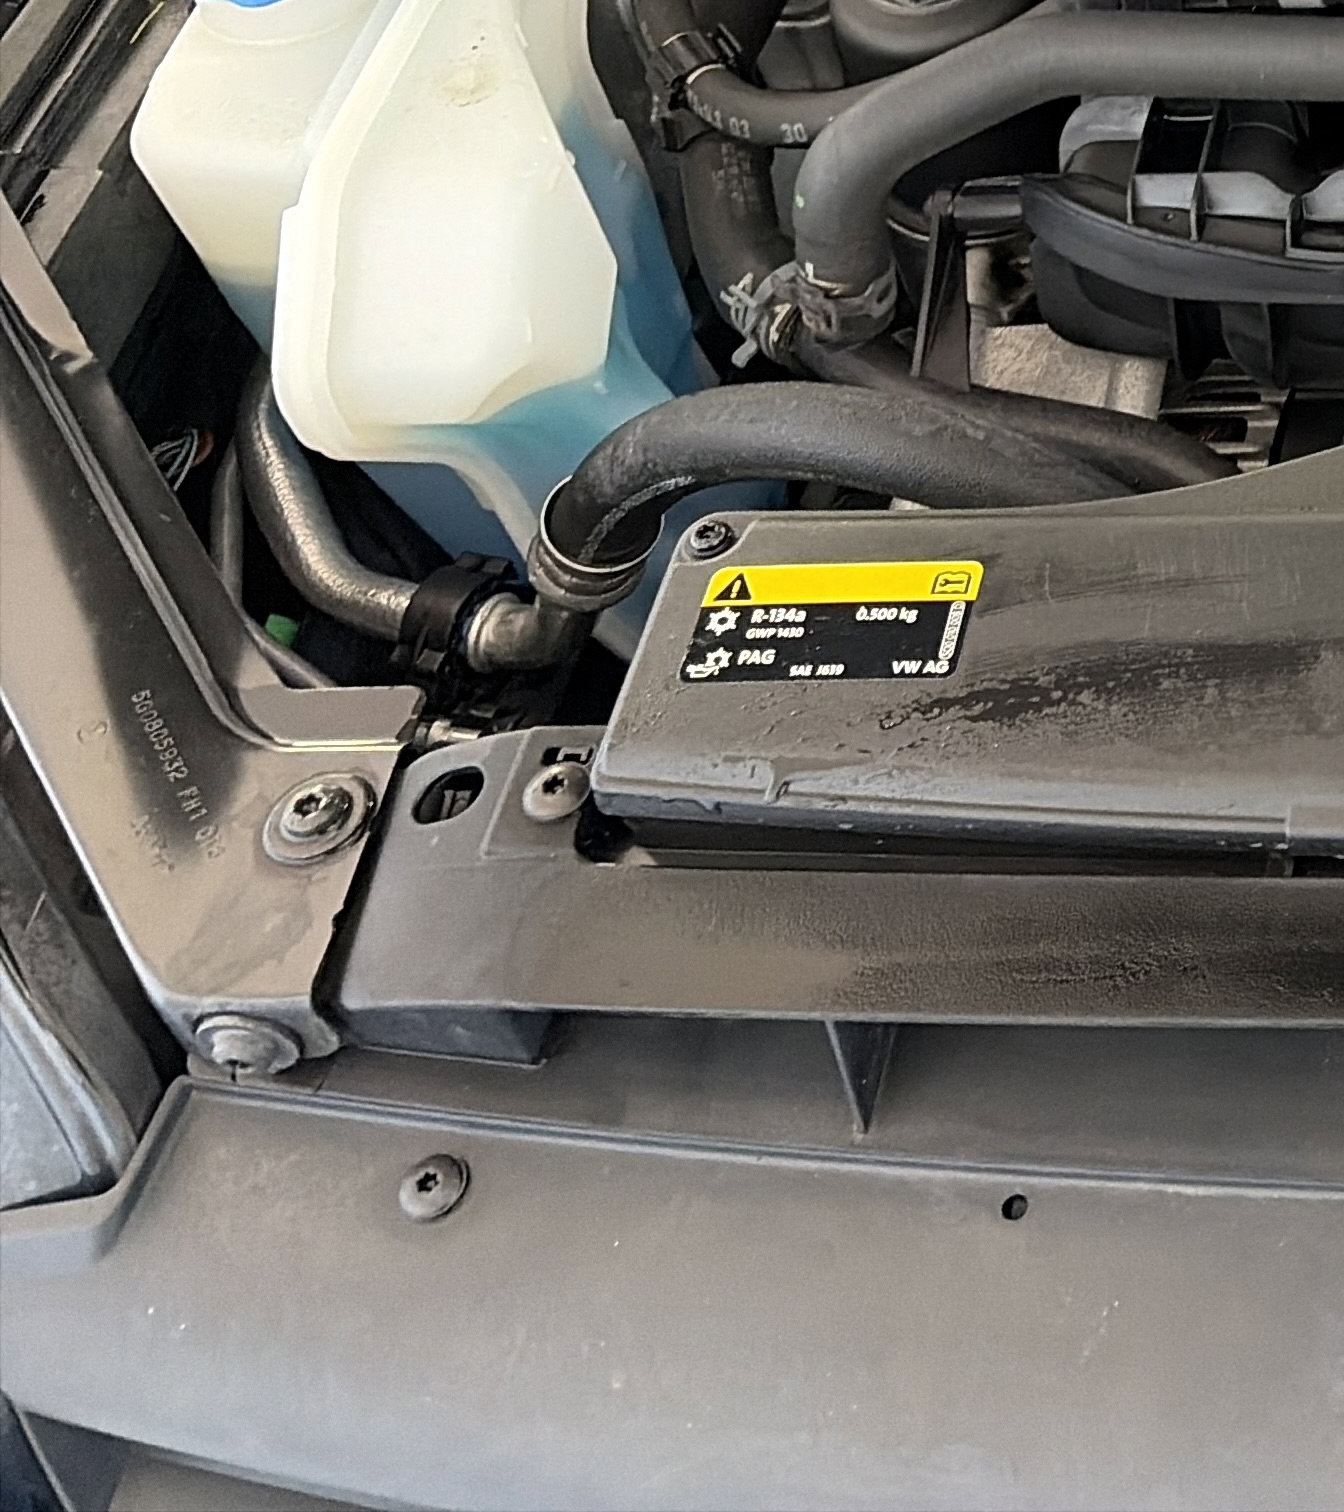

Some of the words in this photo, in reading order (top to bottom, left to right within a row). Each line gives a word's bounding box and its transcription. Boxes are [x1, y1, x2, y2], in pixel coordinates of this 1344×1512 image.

[751, 608, 807, 623] R-134a
[856, 606, 897, 621] 0.500
[899, 607, 918, 624] kg
[746, 628, 775, 639] GWP
[736, 649, 776, 665] PAG
[789, 665, 812, 677] SAE
[892, 661, 920, 675] VW
[923, 660, 949, 674] AG
